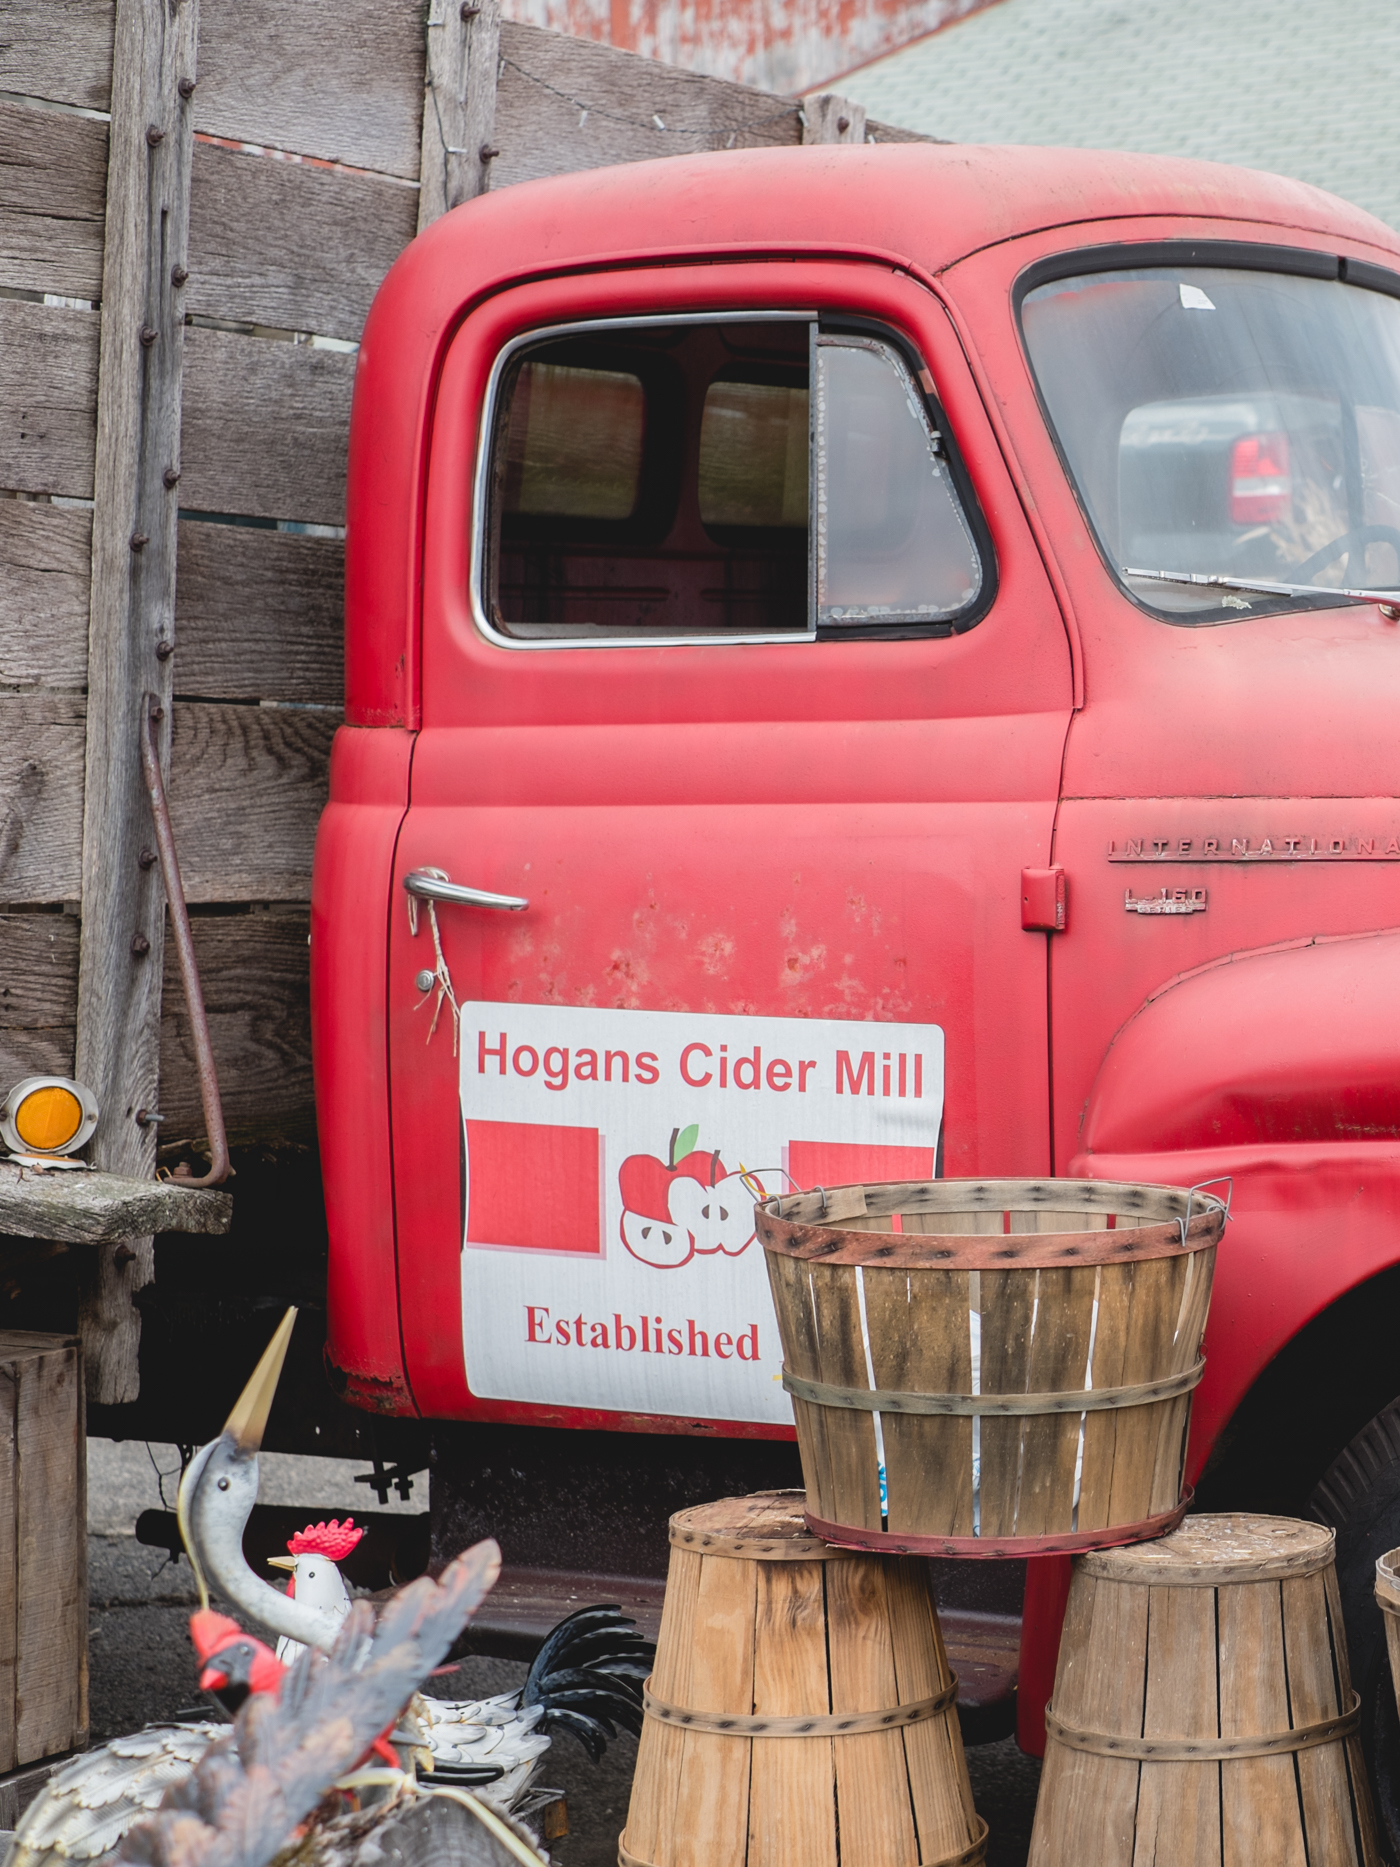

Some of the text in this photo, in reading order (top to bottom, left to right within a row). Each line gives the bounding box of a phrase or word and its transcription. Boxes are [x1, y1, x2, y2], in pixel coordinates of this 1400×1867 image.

[1124, 887, 1207, 904] L-160
[478, 1031, 922, 1098] Hogans Cider Mill
[524, 1305, 761, 1361] Established
